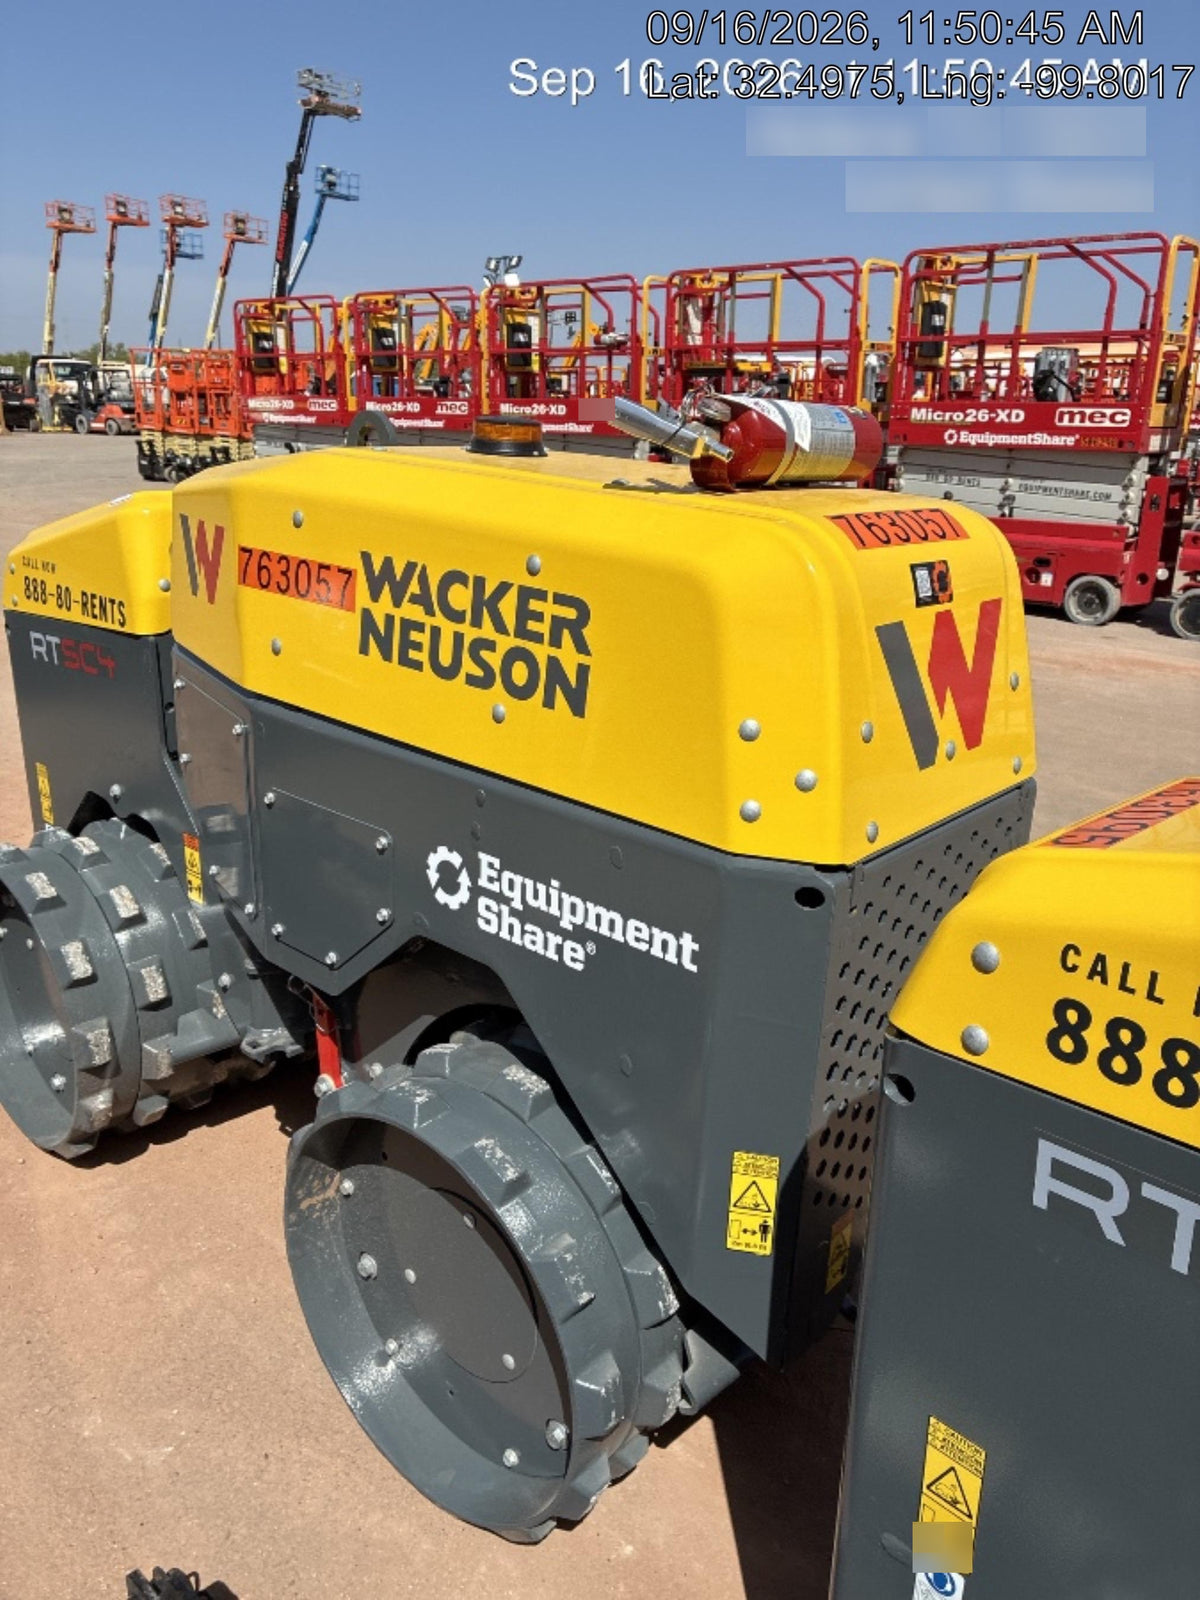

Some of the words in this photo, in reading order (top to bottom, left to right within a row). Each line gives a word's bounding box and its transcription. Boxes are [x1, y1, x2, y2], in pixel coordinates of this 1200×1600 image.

[308, 399, 337, 410] mec
[500, 403, 567, 415] Micro26-XD
[910, 407, 1025, 423] Micro26-XD
[1056, 409, 1130, 426] mec
[831, 508, 961, 547] 763057
[24, 576, 126, 628] 888-80-RENTS
[239, 547, 354, 609] 763057
[359, 550, 593, 656] WACKER
[359, 607, 591, 719] NEUSON
[477, 850, 700, 974] Equipment
[1059, 943, 1165, 1006] CALL
